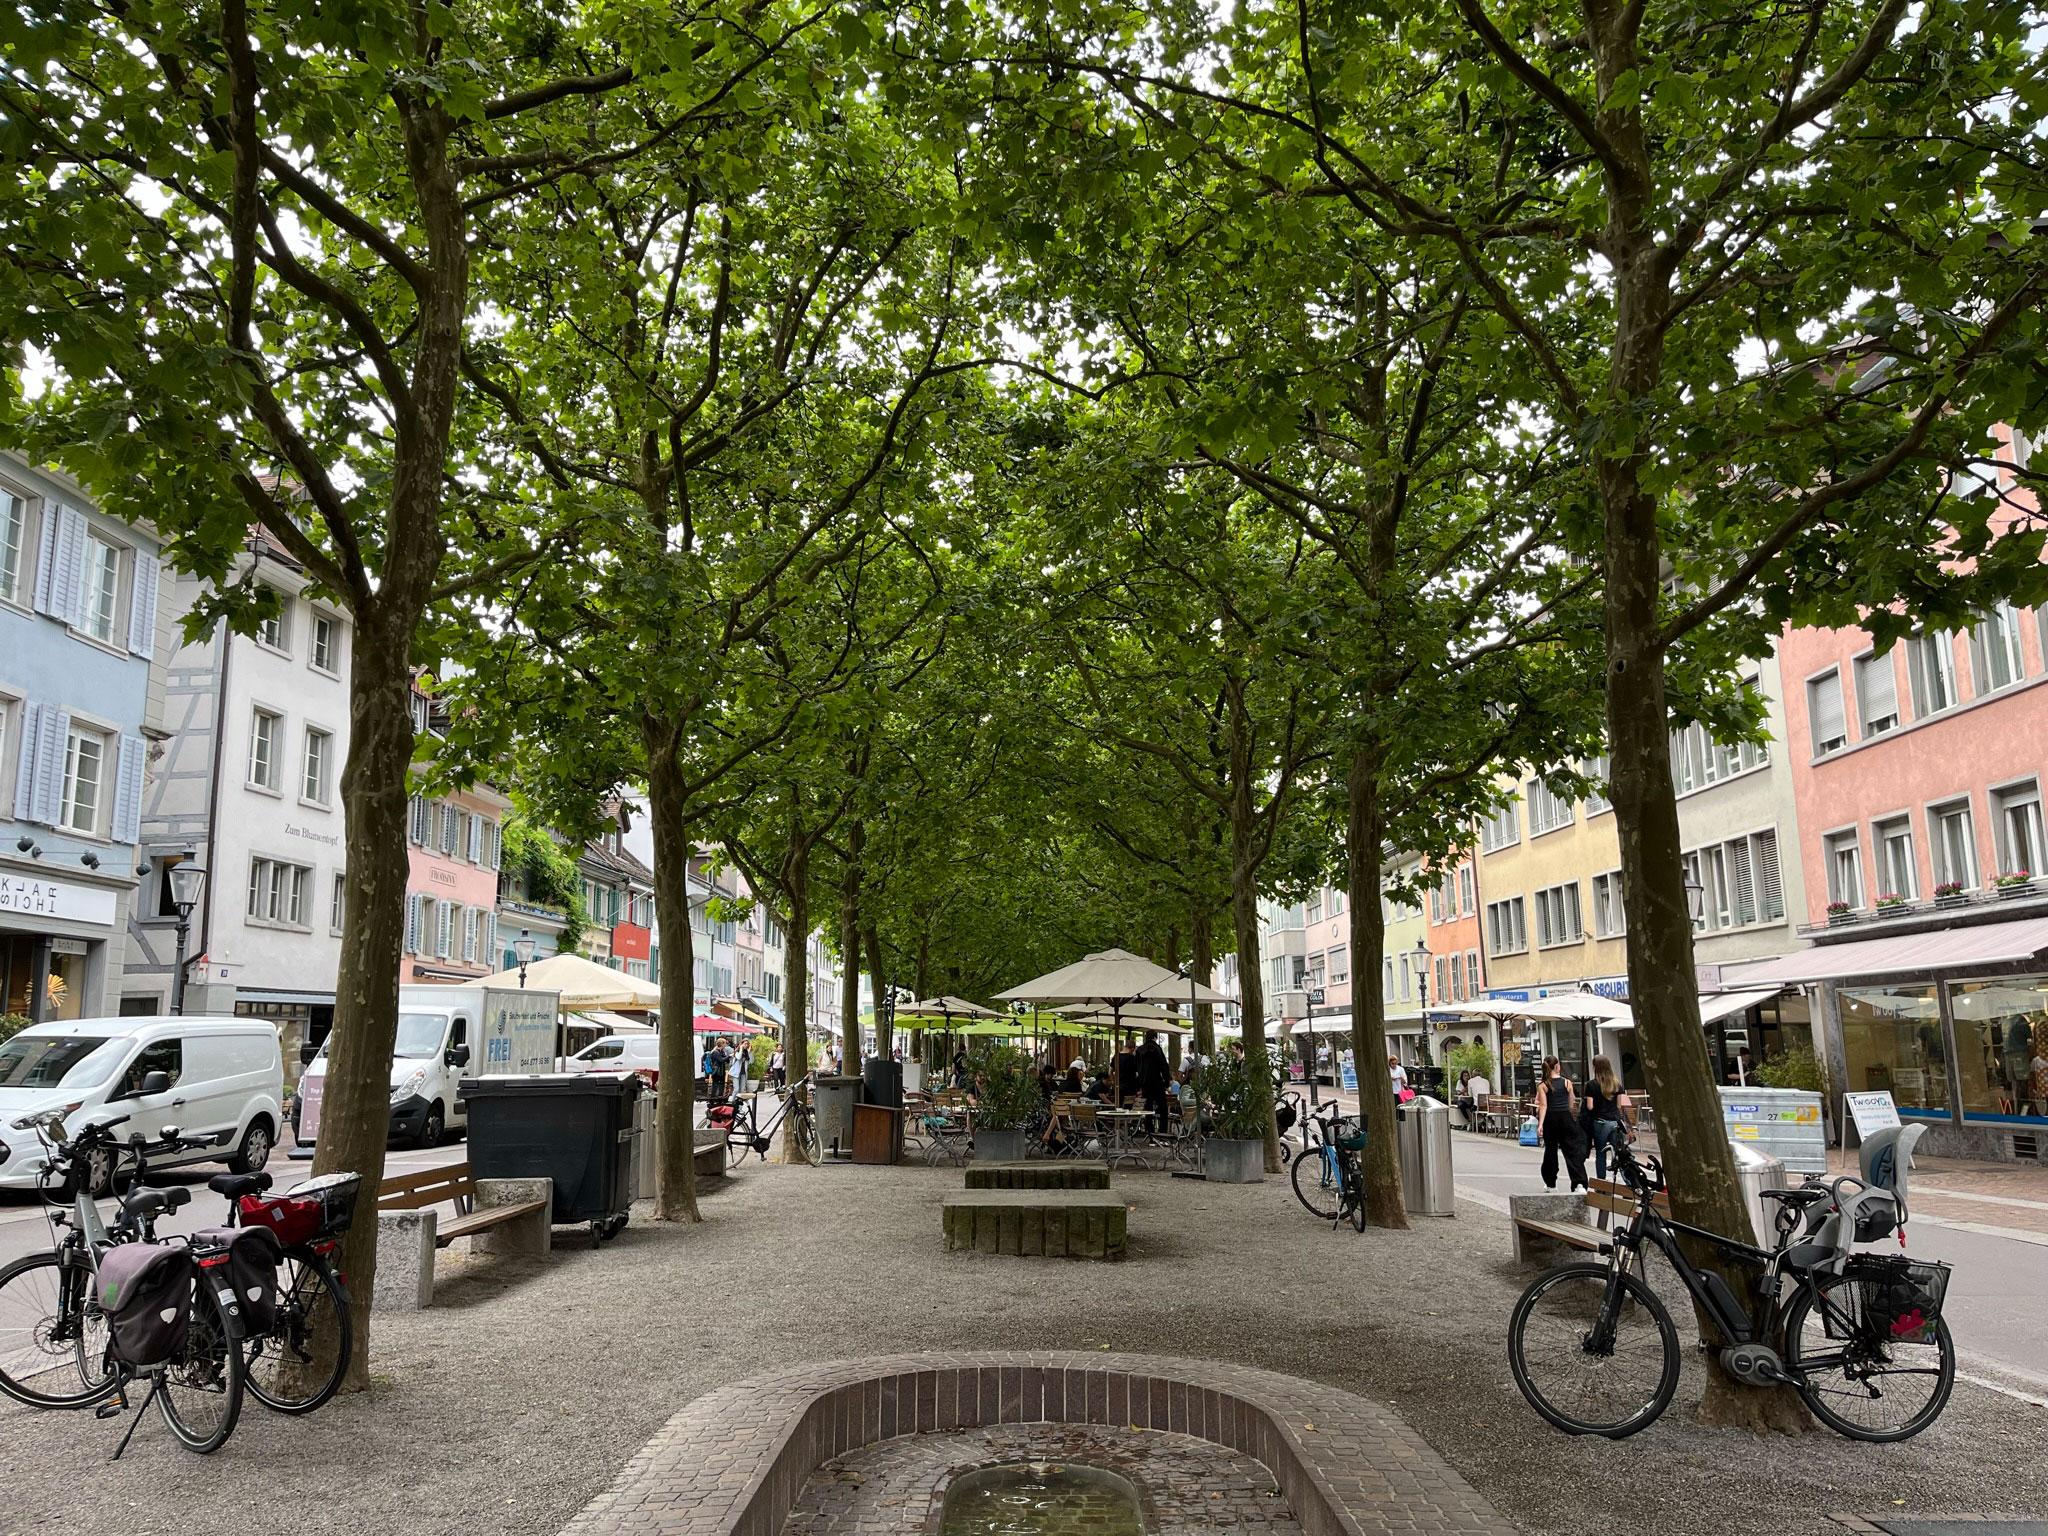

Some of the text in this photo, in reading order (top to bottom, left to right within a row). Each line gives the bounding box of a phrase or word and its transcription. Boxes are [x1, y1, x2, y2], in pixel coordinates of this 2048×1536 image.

[285, 823, 300, 836] Zum
[488, 1038, 511, 1062] FREI
[1767, 1113, 1778, 1121] 27
